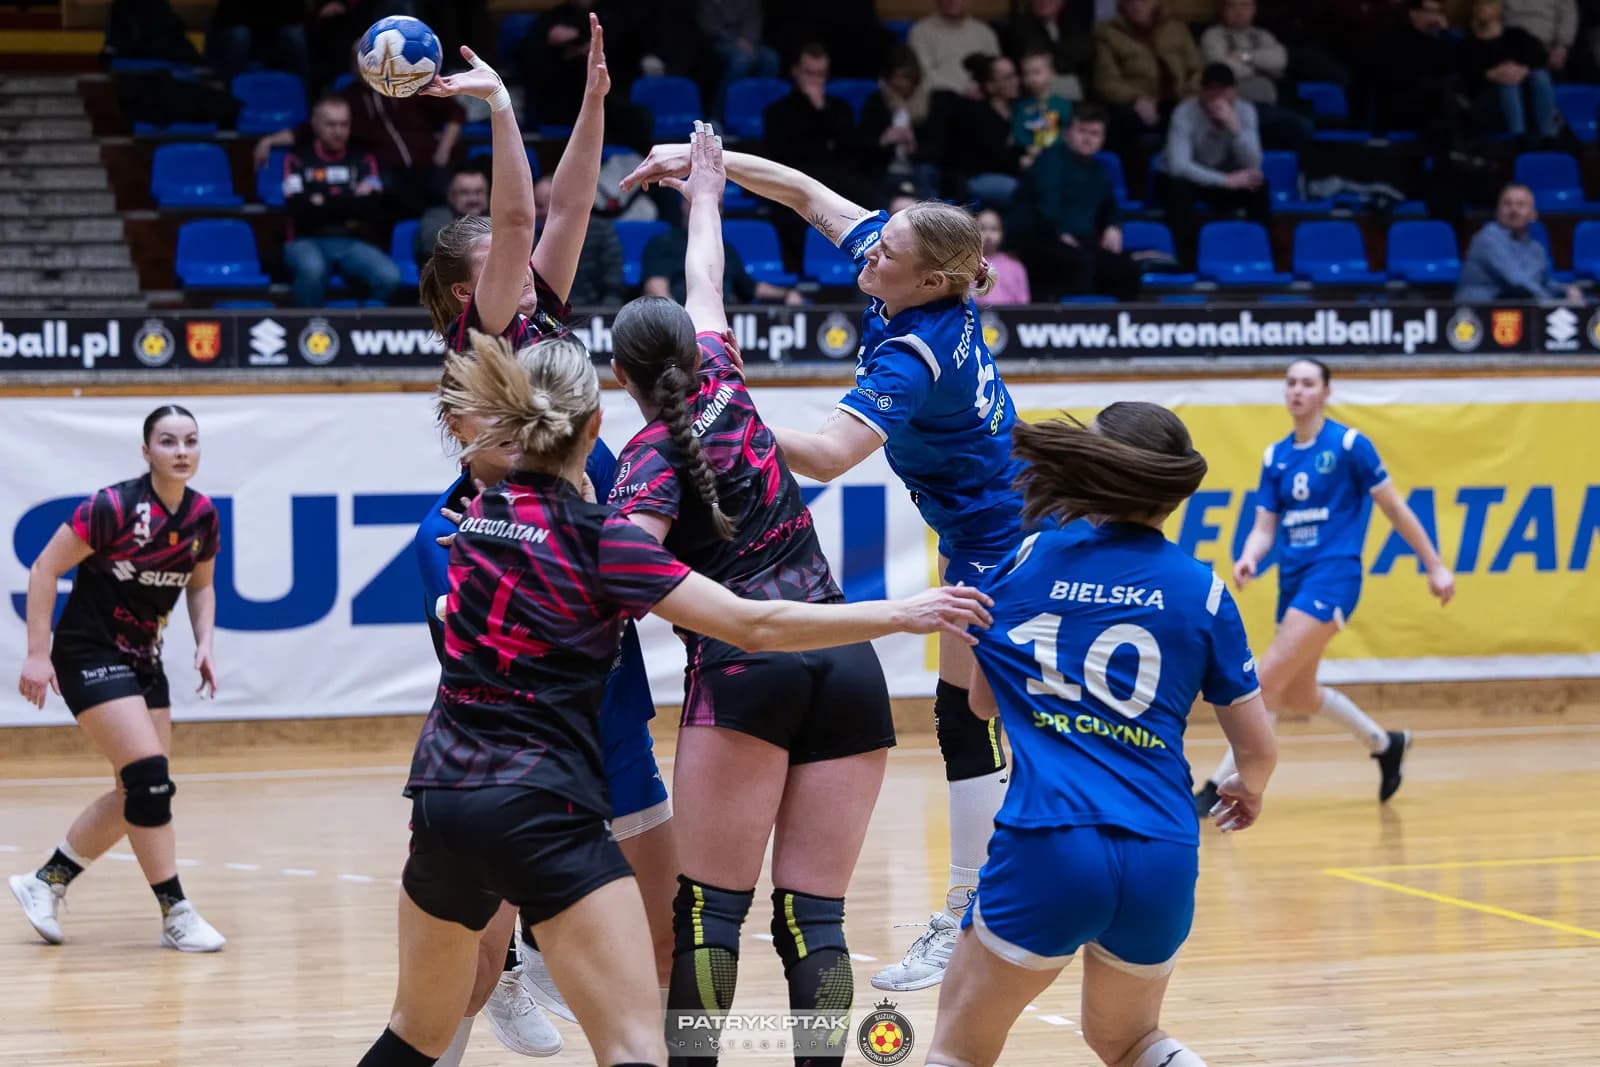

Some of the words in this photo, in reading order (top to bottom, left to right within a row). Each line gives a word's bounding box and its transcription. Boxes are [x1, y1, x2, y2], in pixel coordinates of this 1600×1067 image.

[1017, 311, 1437, 353] www.koronahandball.pl
[608, 482, 649, 499] OFIKA
[1292, 471, 1310, 501] 8
[134, 502, 152, 538] 3
[1049, 580, 1165, 611] BIELSKA
[1007, 612, 1163, 719] 10
